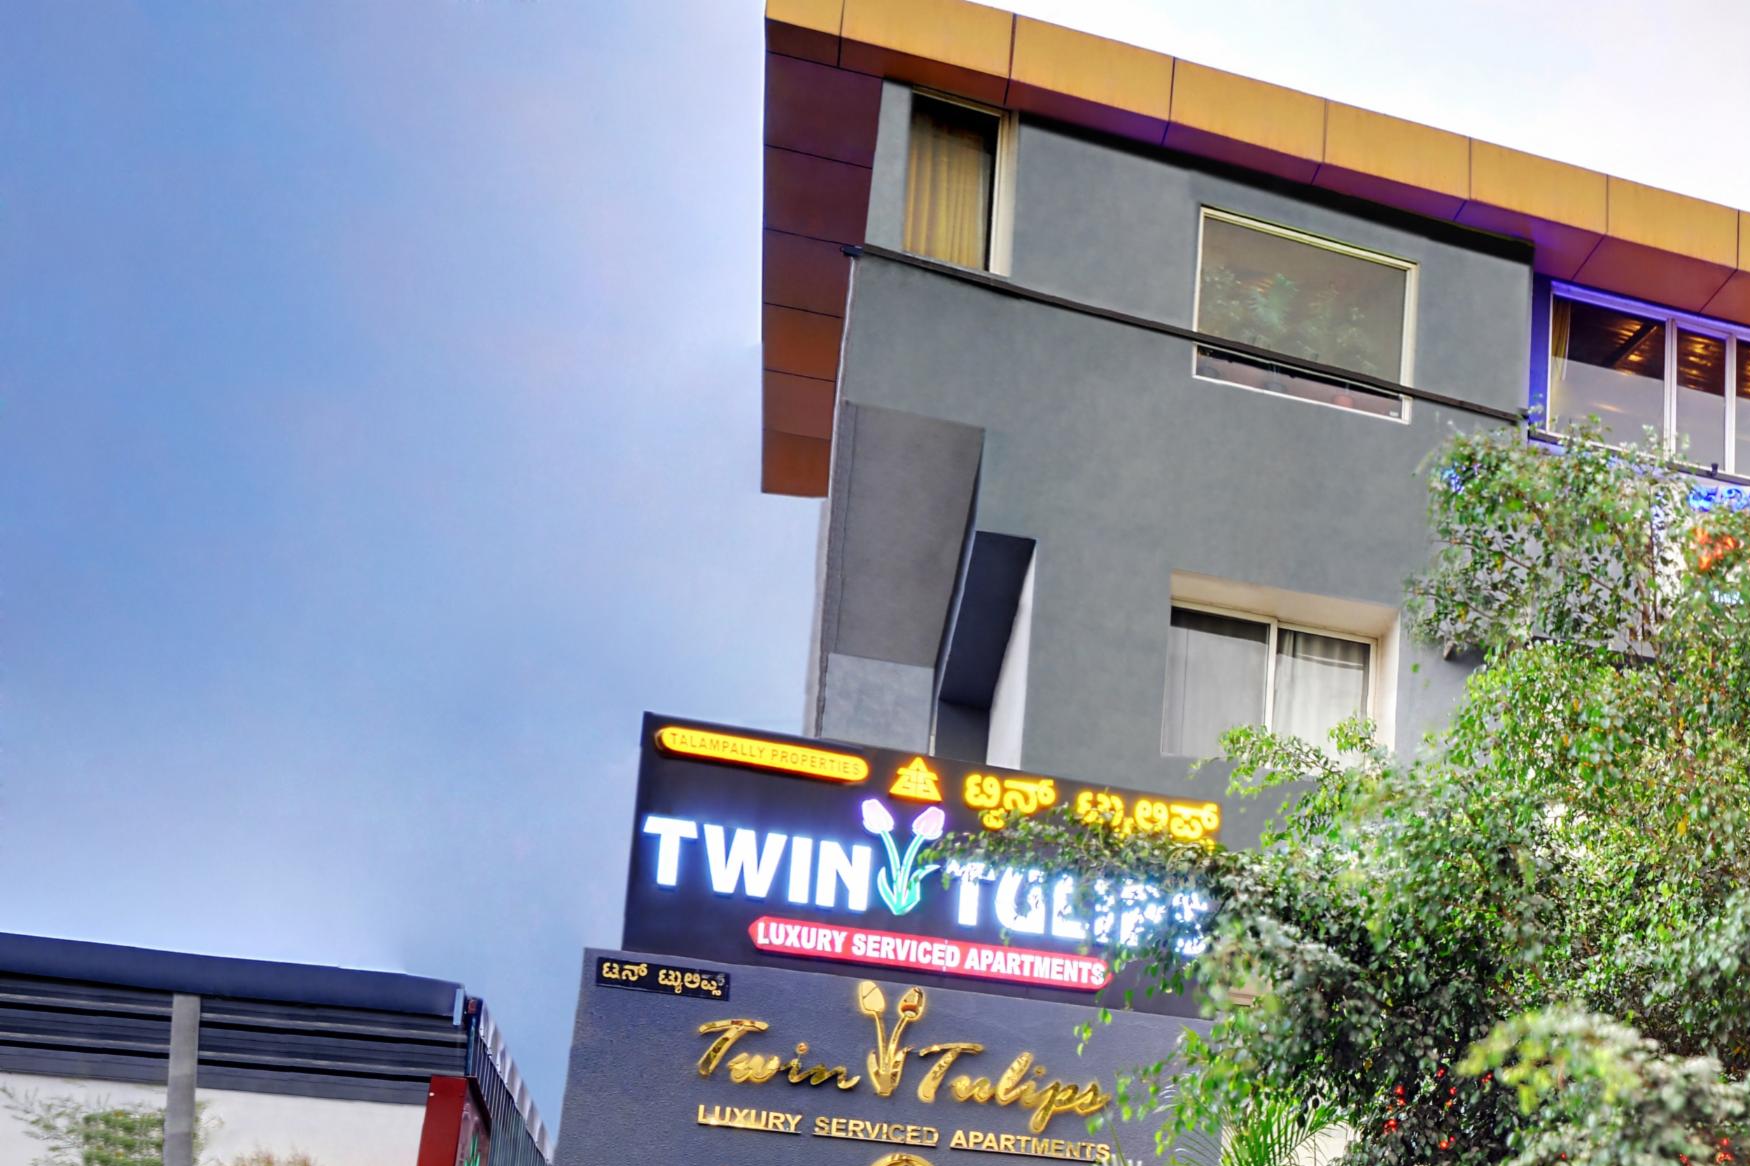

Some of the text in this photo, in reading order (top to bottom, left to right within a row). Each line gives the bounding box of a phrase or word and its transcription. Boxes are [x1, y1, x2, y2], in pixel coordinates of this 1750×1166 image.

[669, 732, 861, 776] TALAMPALLY PROPERTIES
[643, 815, 873, 912] TWIN
[757, 921, 1106, 986] LUXURY SERVICED APARTMENTS
[698, 1018, 1112, 1133] Twin Tulips
[697, 1103, 1111, 1161] LUXURY SERVICED APARTMENTS
